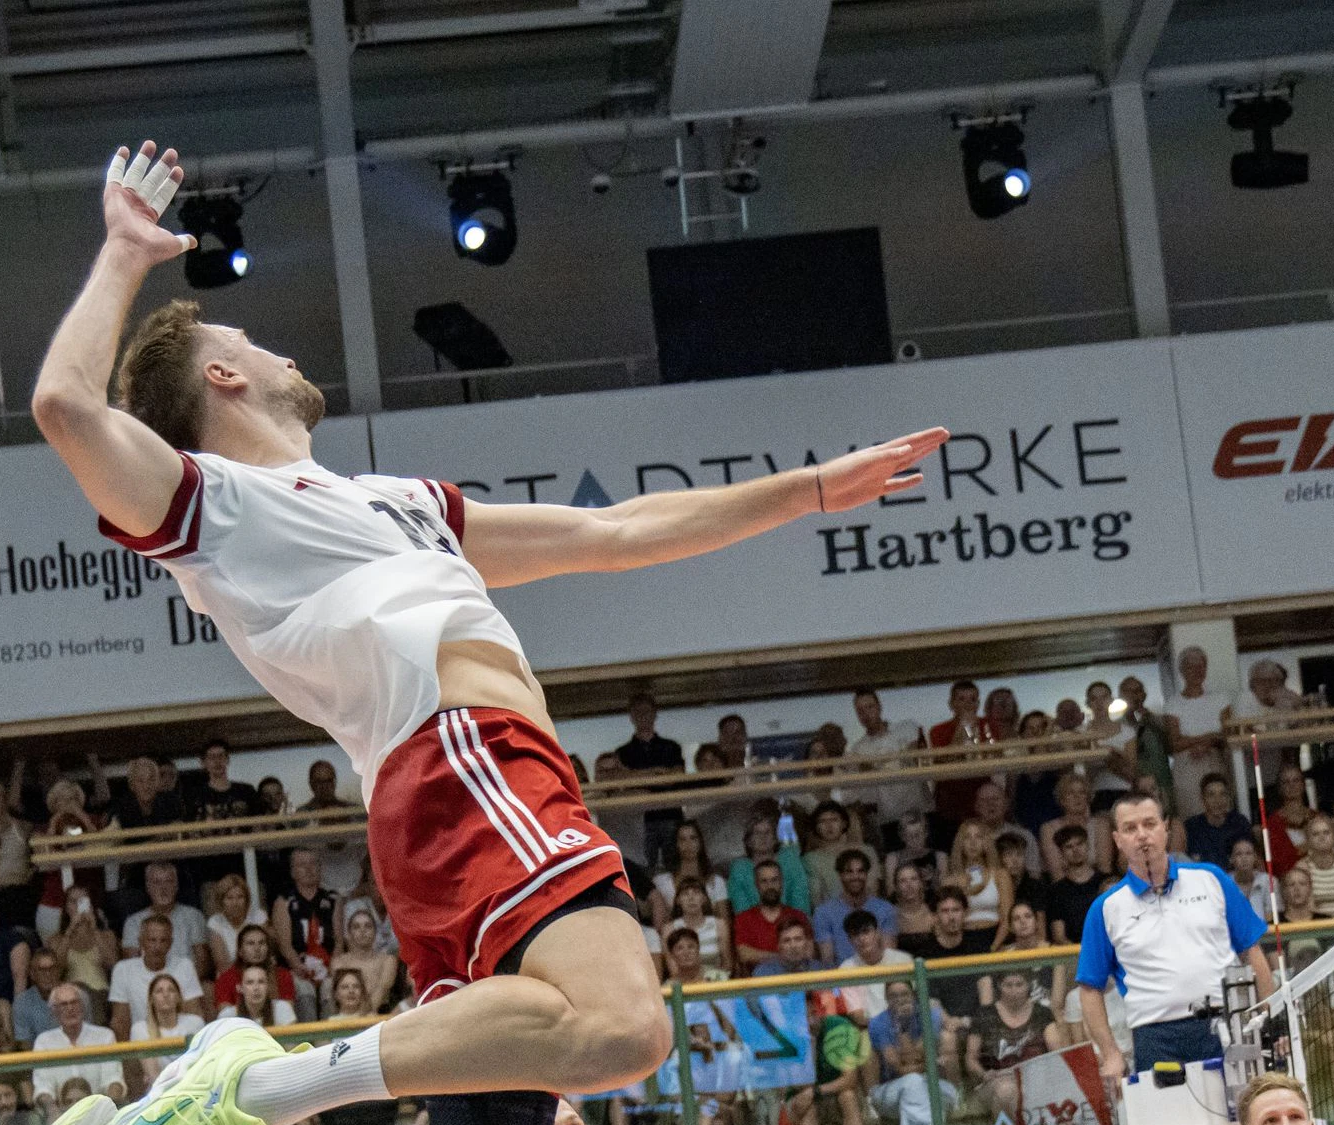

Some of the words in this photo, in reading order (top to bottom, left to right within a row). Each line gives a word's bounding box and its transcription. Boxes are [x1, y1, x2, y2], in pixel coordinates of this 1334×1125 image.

[817, 510, 1132, 576] Hartberg
[0, 640, 52, 664] 8230
[59, 635, 144, 656] Hartberg
